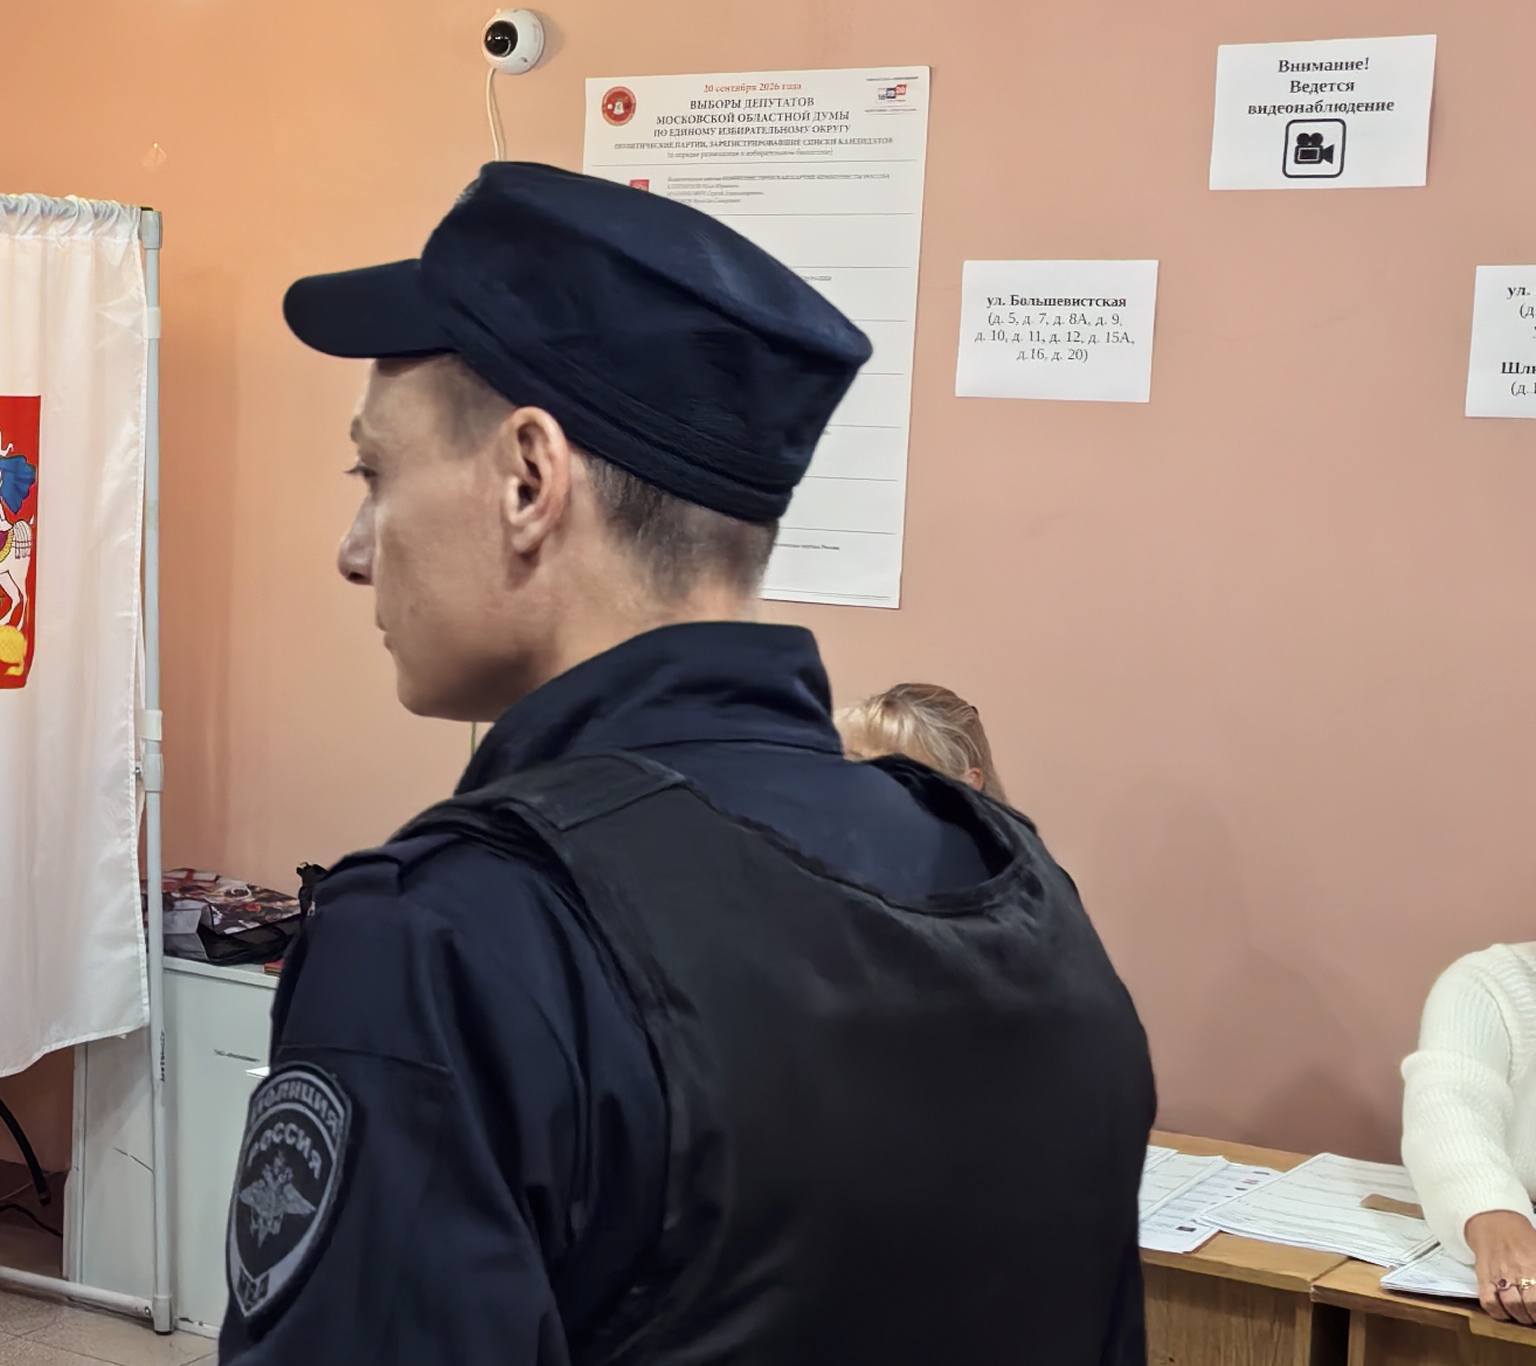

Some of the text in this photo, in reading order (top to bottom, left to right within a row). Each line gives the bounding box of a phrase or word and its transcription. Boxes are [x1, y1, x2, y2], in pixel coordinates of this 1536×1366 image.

[1277, 57, 1370, 74] Внимание!
[759, 82, 780, 91] 2026
[1289, 80, 1355, 95] Ведется
[689, 96, 815, 110] ВЫБОРЫ ДЕПУТАТОВ
[1247, 99, 1395, 116] видеонаблюдение
[656, 112, 735, 125] МОСКОВСКОЙ
[737, 110, 811, 124] ОБЛАСТНОЙ
[813, 110, 850, 123] ДУМЫ
[653, 124, 851, 138] ПО ЕДИНОМУ ИЗБИРАТЕЛЬНОМУ ОКРУГУ
[1506, 286, 1531, 300] ул.
[986, 294, 1127, 309] ул. Большевистская
[987, 312, 1004, 326] (д.
[1008, 312, 1019, 326] 5,
[1038, 312, 1049, 326] 7,
[1052, 315, 1065, 326] д.
[1095, 315, 1107, 327] д.
[1111, 313, 1123, 327] 9,
[974, 331, 986, 343] д.
[990, 329, 1009, 343] 10,
[1029, 330, 1046, 344] 11,
[1049, 332, 1061, 344] д.
[1066, 331, 1085, 344] 12,
[1087, 333, 1100, 345] д.
[1051, 350, 1063, 362] д.
[1067, 348, 1089, 363] 20)
[1510, 381, 1529, 397] (д.
[250, 1080, 339, 1140] ПОЛИЦИЯ
[246, 1122, 323, 1180] РОССИЯ
